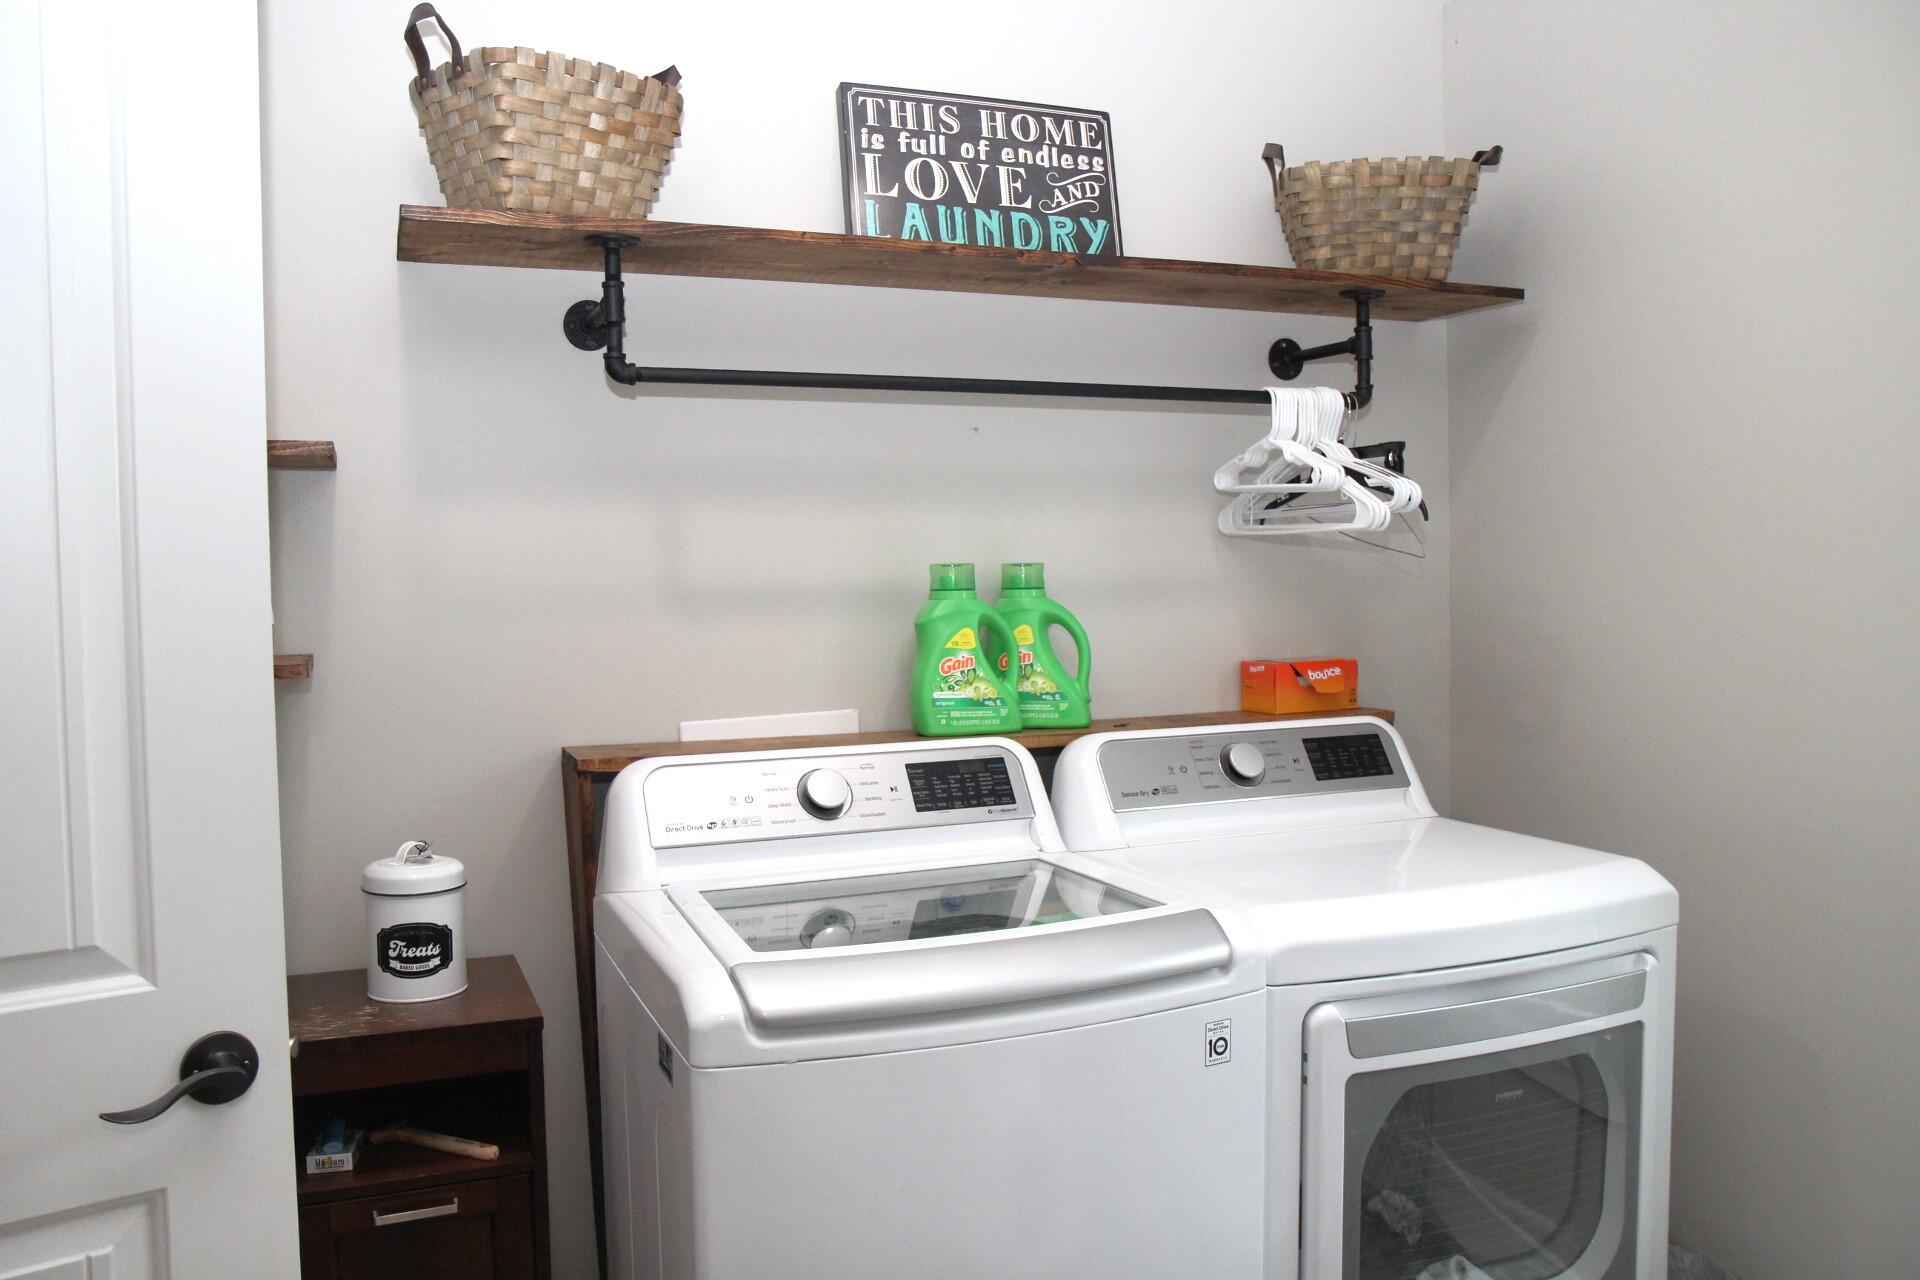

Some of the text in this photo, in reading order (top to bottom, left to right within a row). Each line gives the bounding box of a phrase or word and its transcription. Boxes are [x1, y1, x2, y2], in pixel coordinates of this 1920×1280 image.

[857, 96, 1102, 150] THIS HOME
[860, 128, 1104, 172] is full of endless
[861, 152, 1100, 209] LOVE AND
[863, 199, 1111, 256] LAUNDRY
[939, 655, 976, 676] Gain
[1307, 666, 1341, 680] bounce
[388, 940, 441, 958] Treats
[1208, 1036, 1228, 1058] 10
